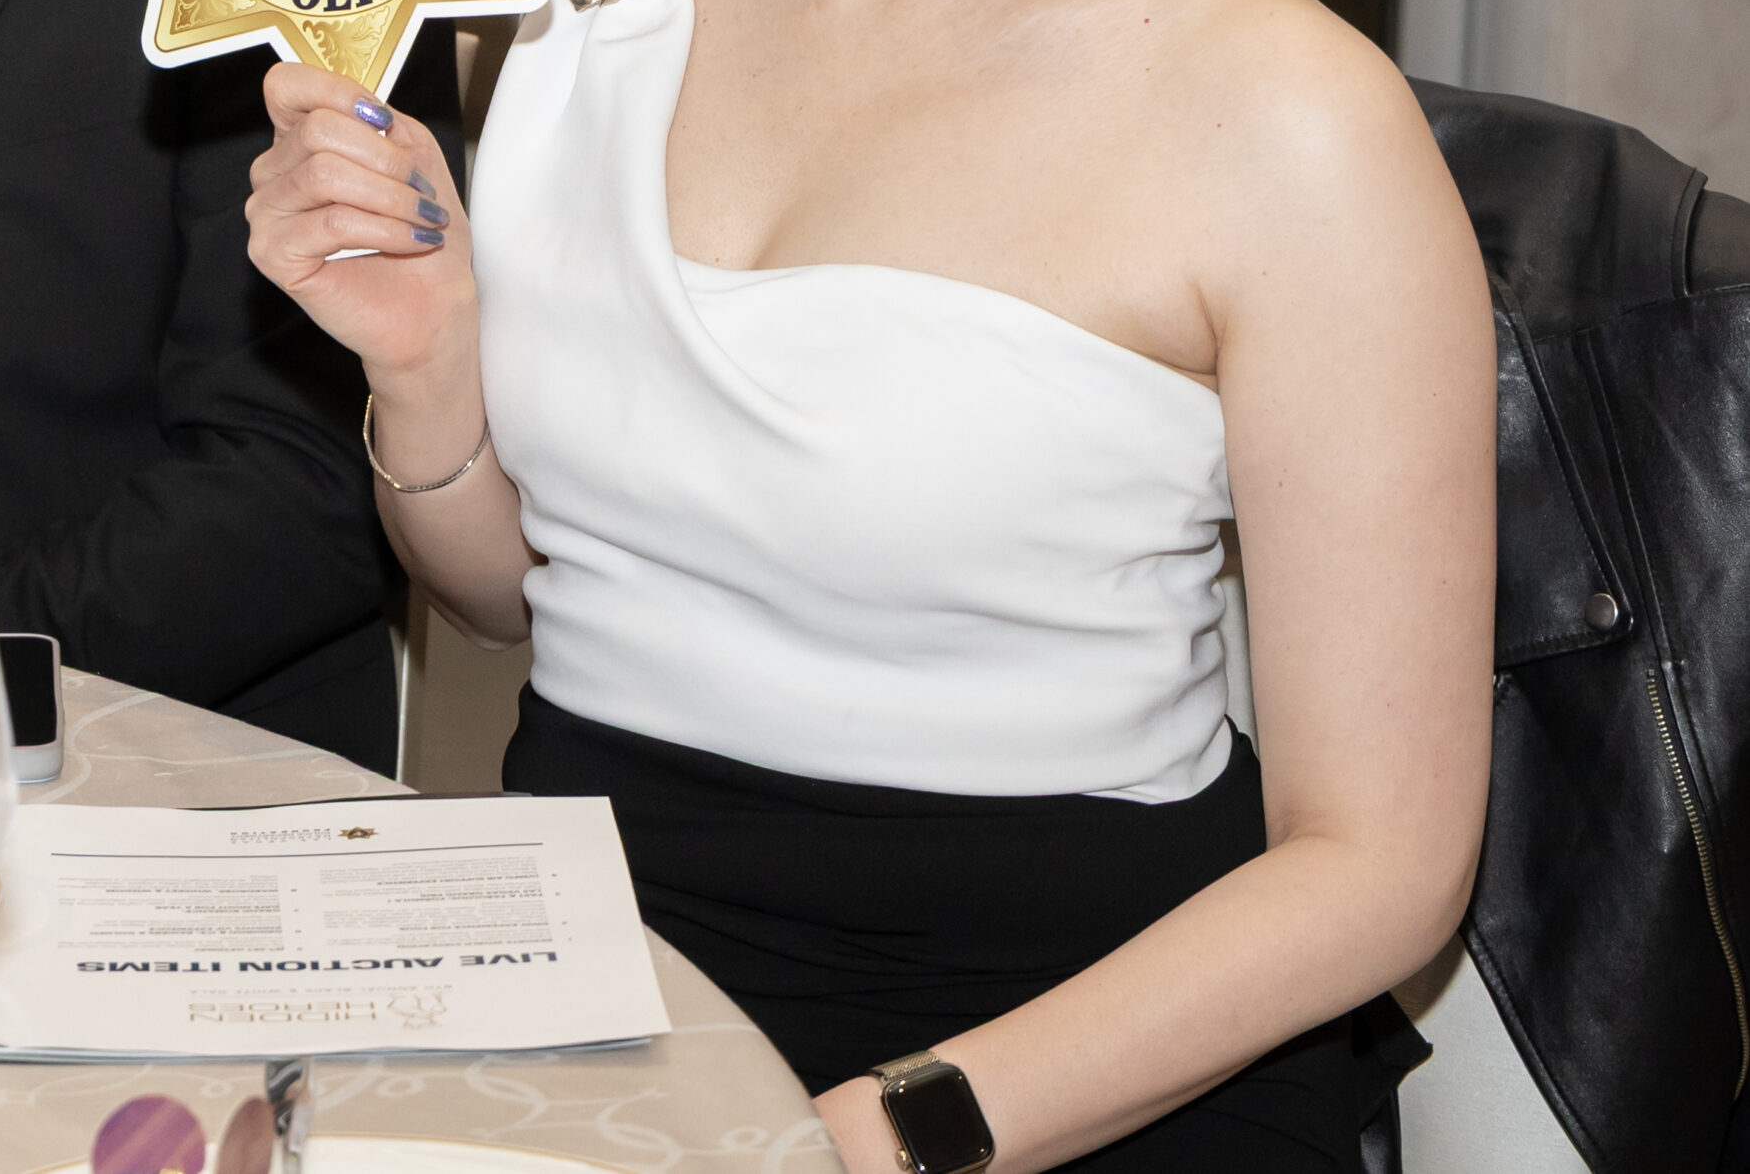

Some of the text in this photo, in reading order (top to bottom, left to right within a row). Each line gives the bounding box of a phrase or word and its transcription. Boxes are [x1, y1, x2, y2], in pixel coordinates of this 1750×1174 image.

[76, 951, 557, 973] LIVE AUCTION ITEMS
[188, 1001, 375, 1011] HEROES
[190, 1012, 377, 1022] HIDDEN
